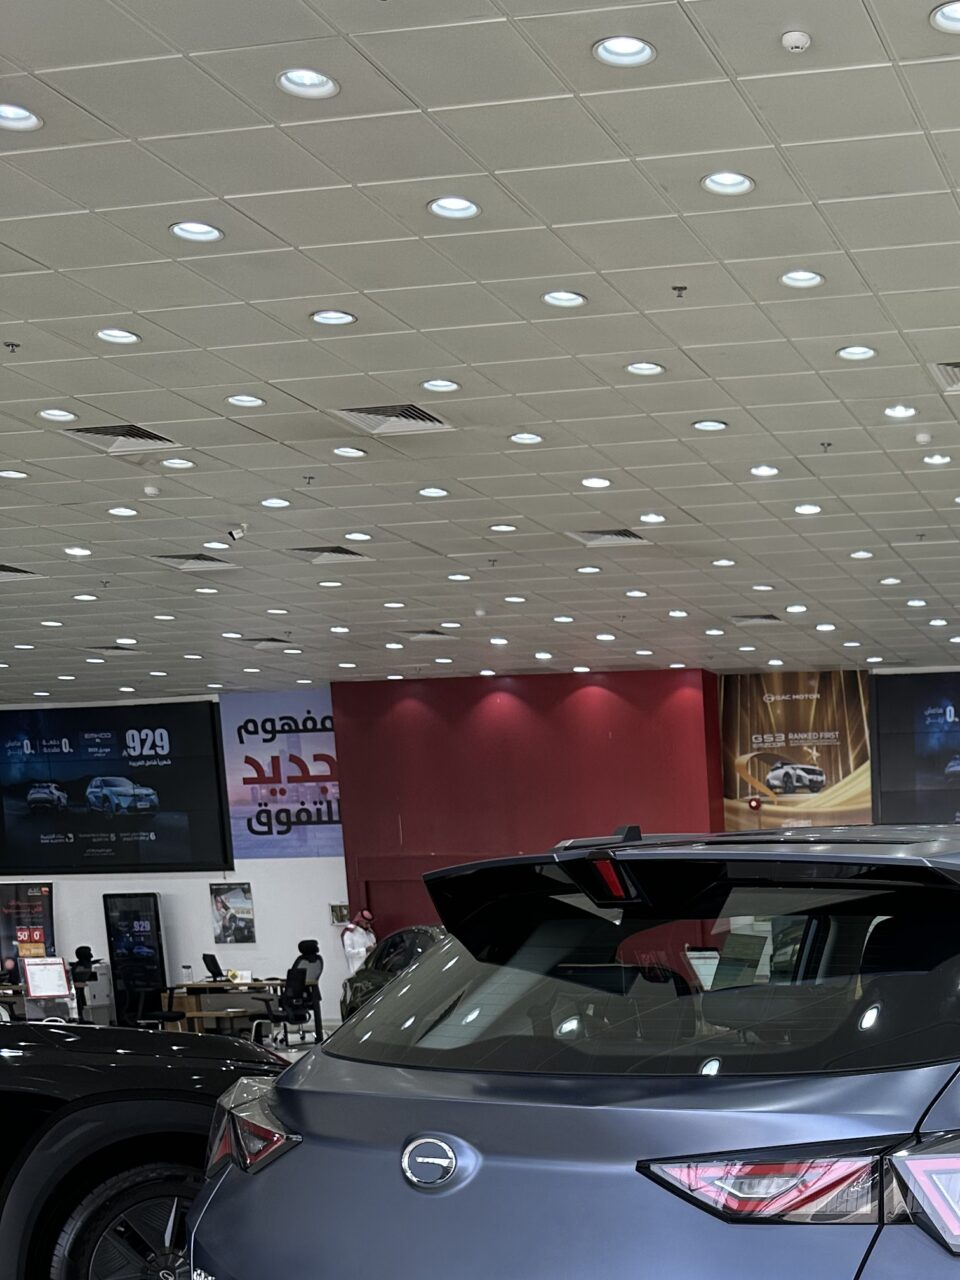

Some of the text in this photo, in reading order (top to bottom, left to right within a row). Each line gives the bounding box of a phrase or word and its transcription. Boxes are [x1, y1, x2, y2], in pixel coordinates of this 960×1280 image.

[236, 709, 334, 744] مفهوم
[788, 731, 840, 740] RANKED FIRST
[126, 727, 171, 757] 929
[752, 733, 786, 743] GS3
[242, 753, 339, 797] جديد
[133, 921, 151, 932] 929
